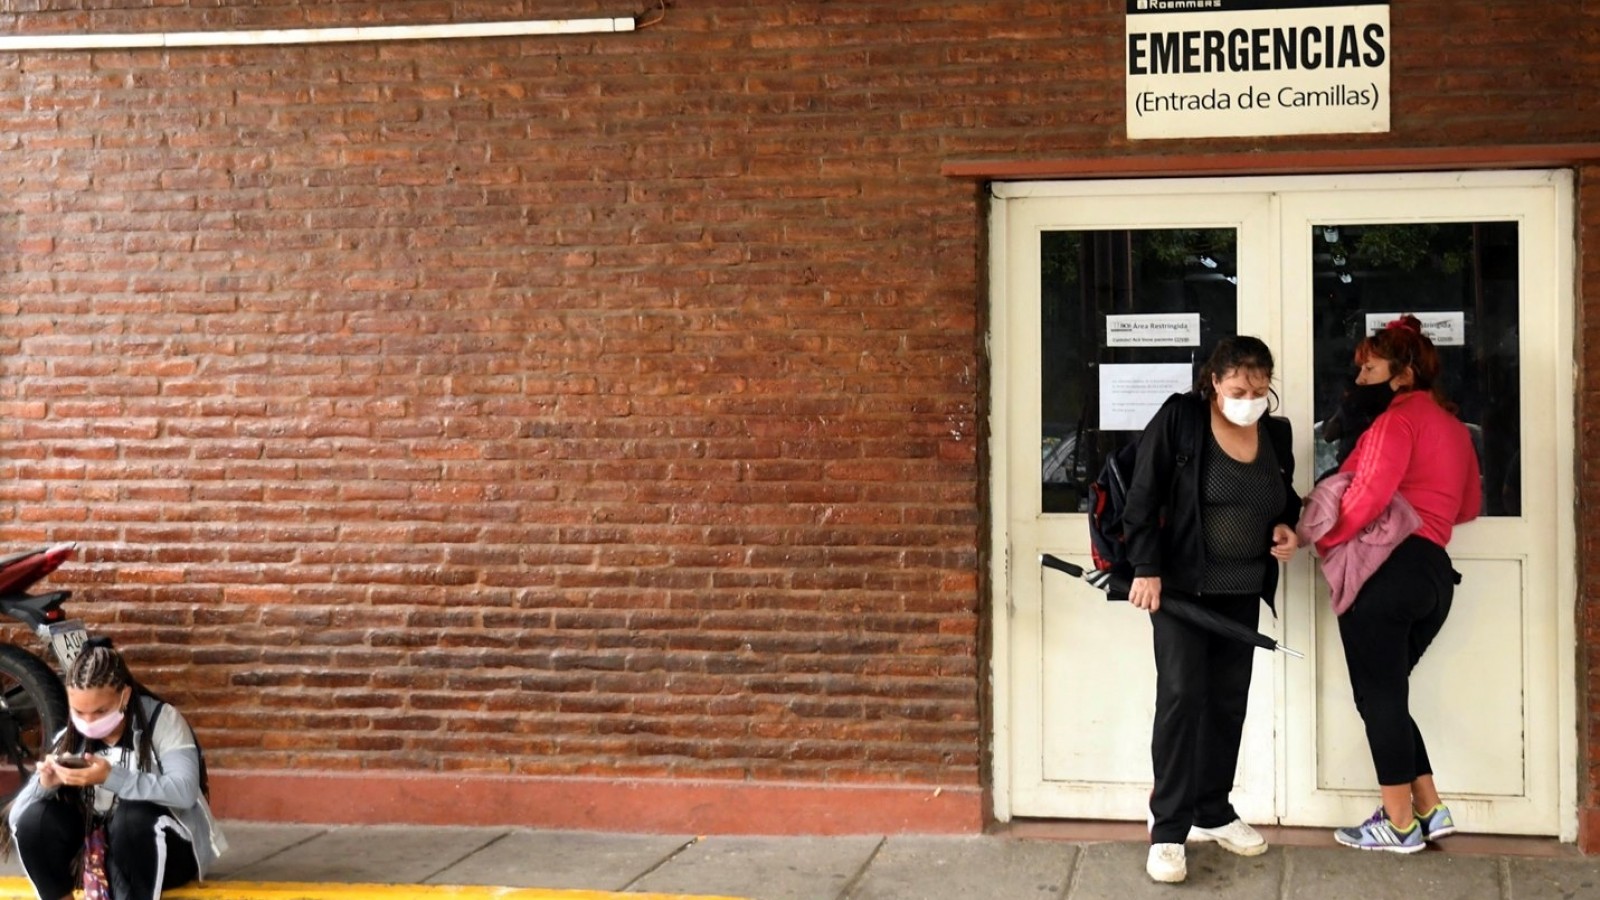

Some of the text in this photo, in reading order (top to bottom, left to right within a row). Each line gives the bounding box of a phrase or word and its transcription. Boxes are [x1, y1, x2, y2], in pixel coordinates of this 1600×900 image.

[1129, 23, 1385, 75] EMERGENCIAS
[1135, 83, 1379, 117] (Entrada de Camillas)
